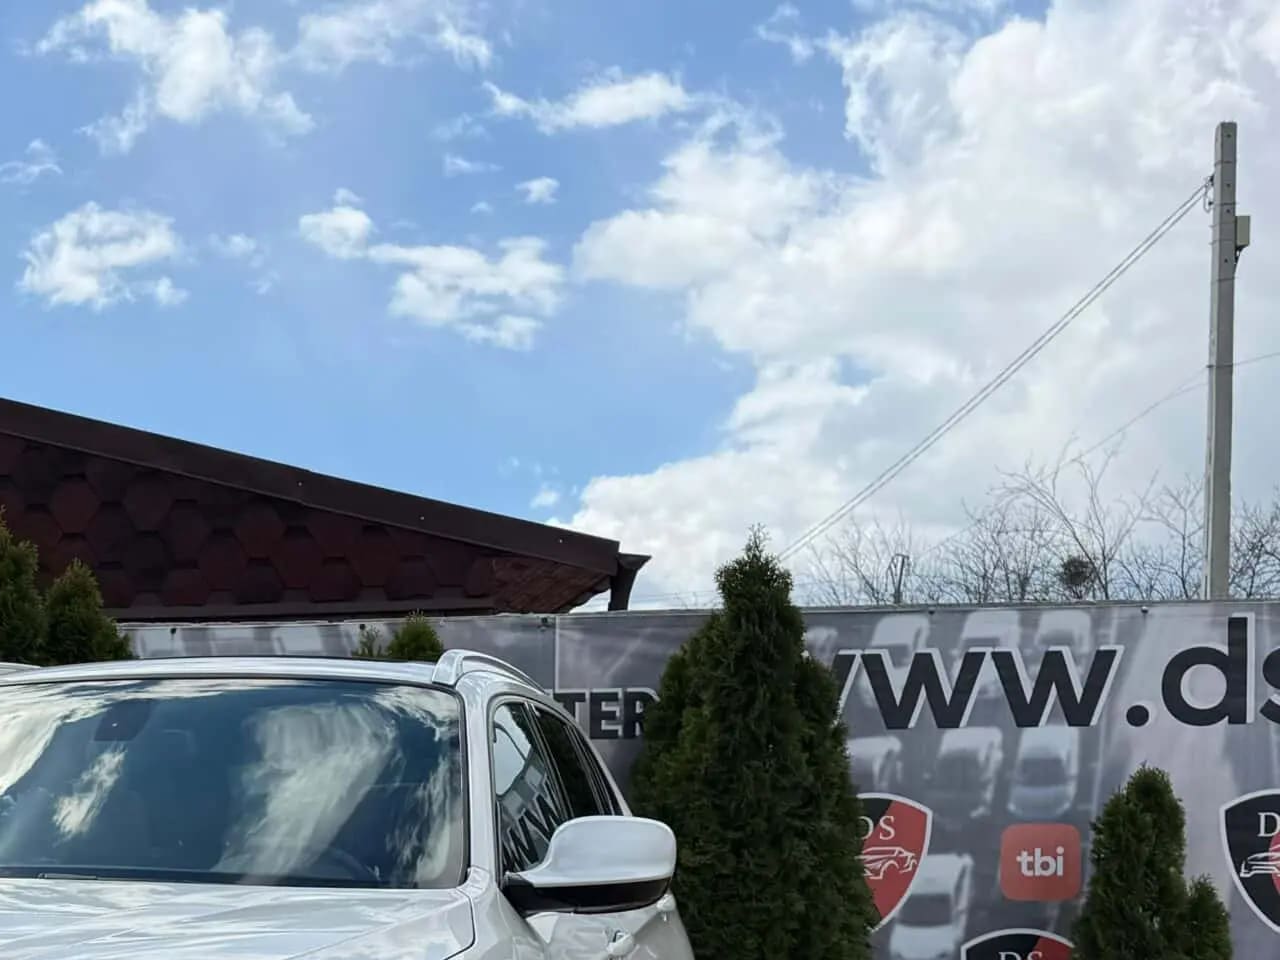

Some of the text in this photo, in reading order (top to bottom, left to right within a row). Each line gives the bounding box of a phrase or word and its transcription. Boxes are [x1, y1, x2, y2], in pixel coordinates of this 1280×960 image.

[831, 615, 1280, 730] ww.d
[1257, 811, 1280, 837] D
[1016, 846, 1065, 877] tbi
